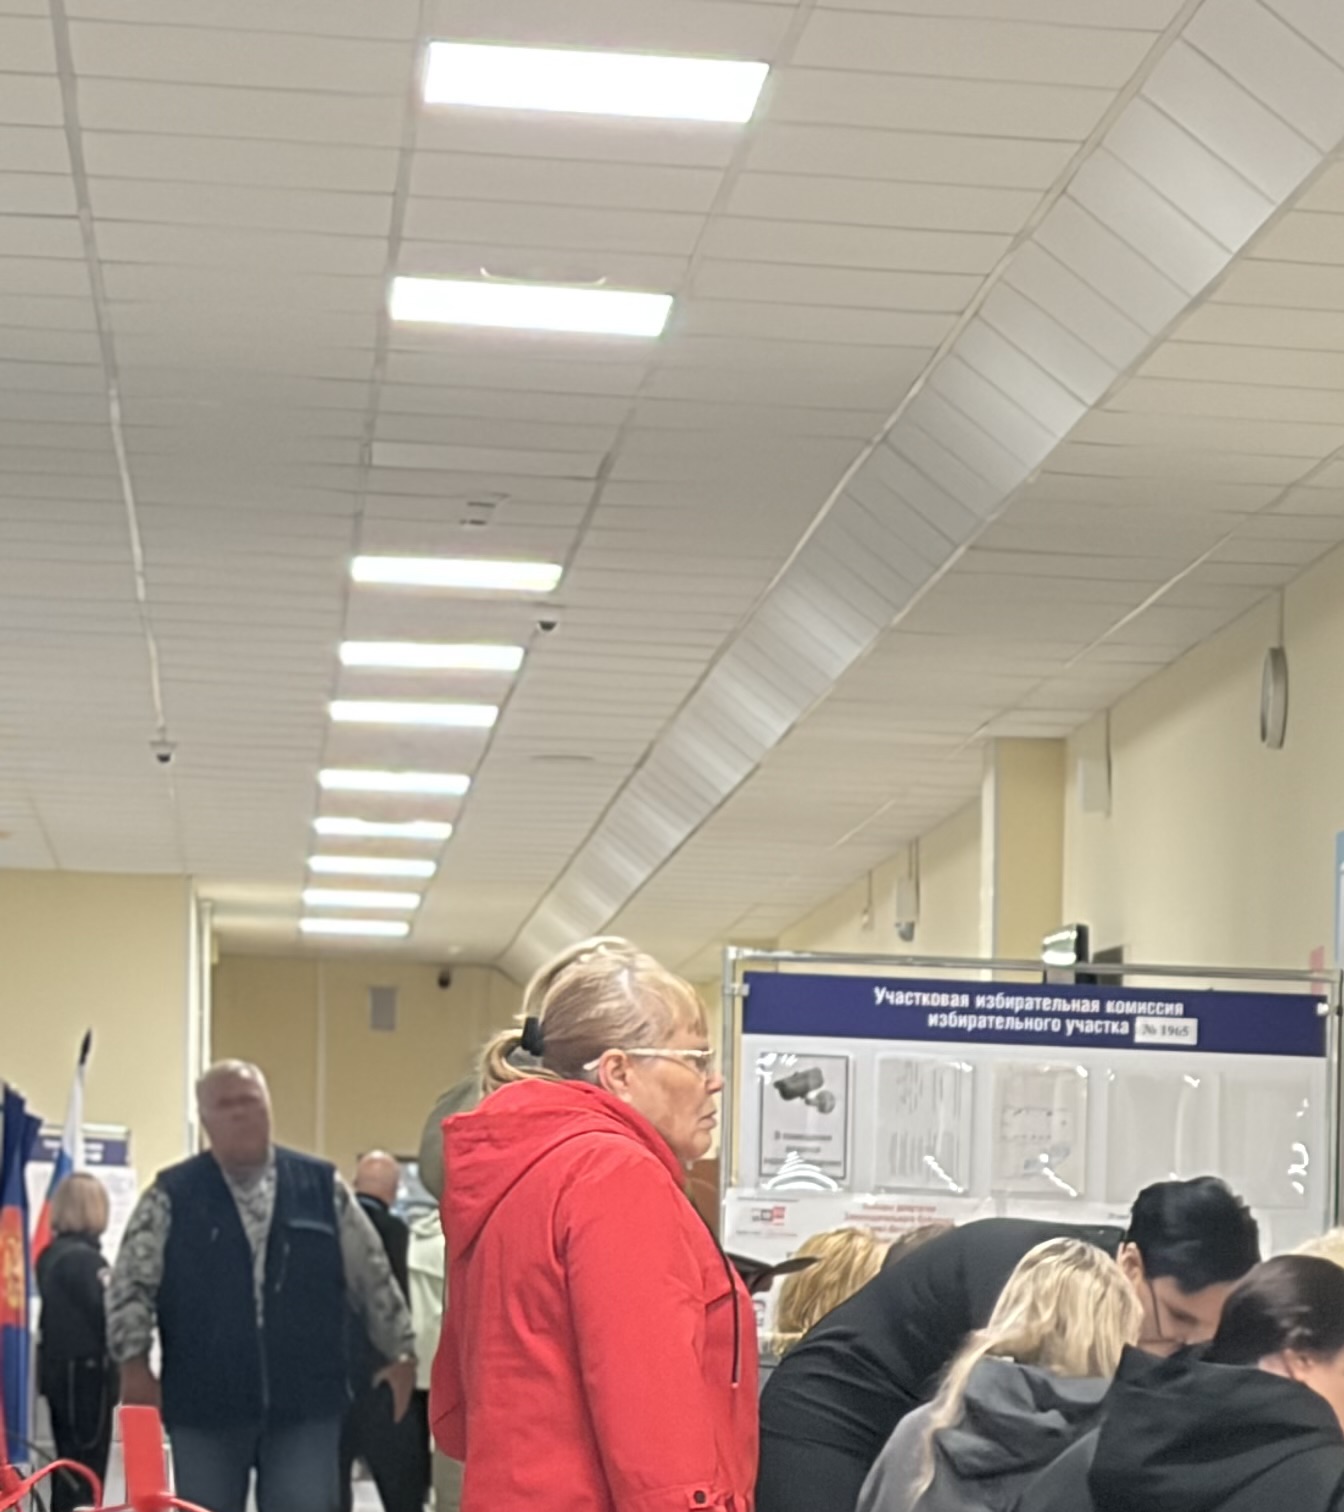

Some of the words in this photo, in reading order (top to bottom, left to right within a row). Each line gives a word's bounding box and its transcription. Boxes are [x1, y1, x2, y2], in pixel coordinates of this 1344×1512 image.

[874, 986, 969, 1007] Участковая
[975, 992, 1100, 1013] избирательная
[1106, 999, 1184, 1016] комиссия
[928, 1011, 1061, 1032] избирательного
[1066, 1018, 1129, 1036] участка
